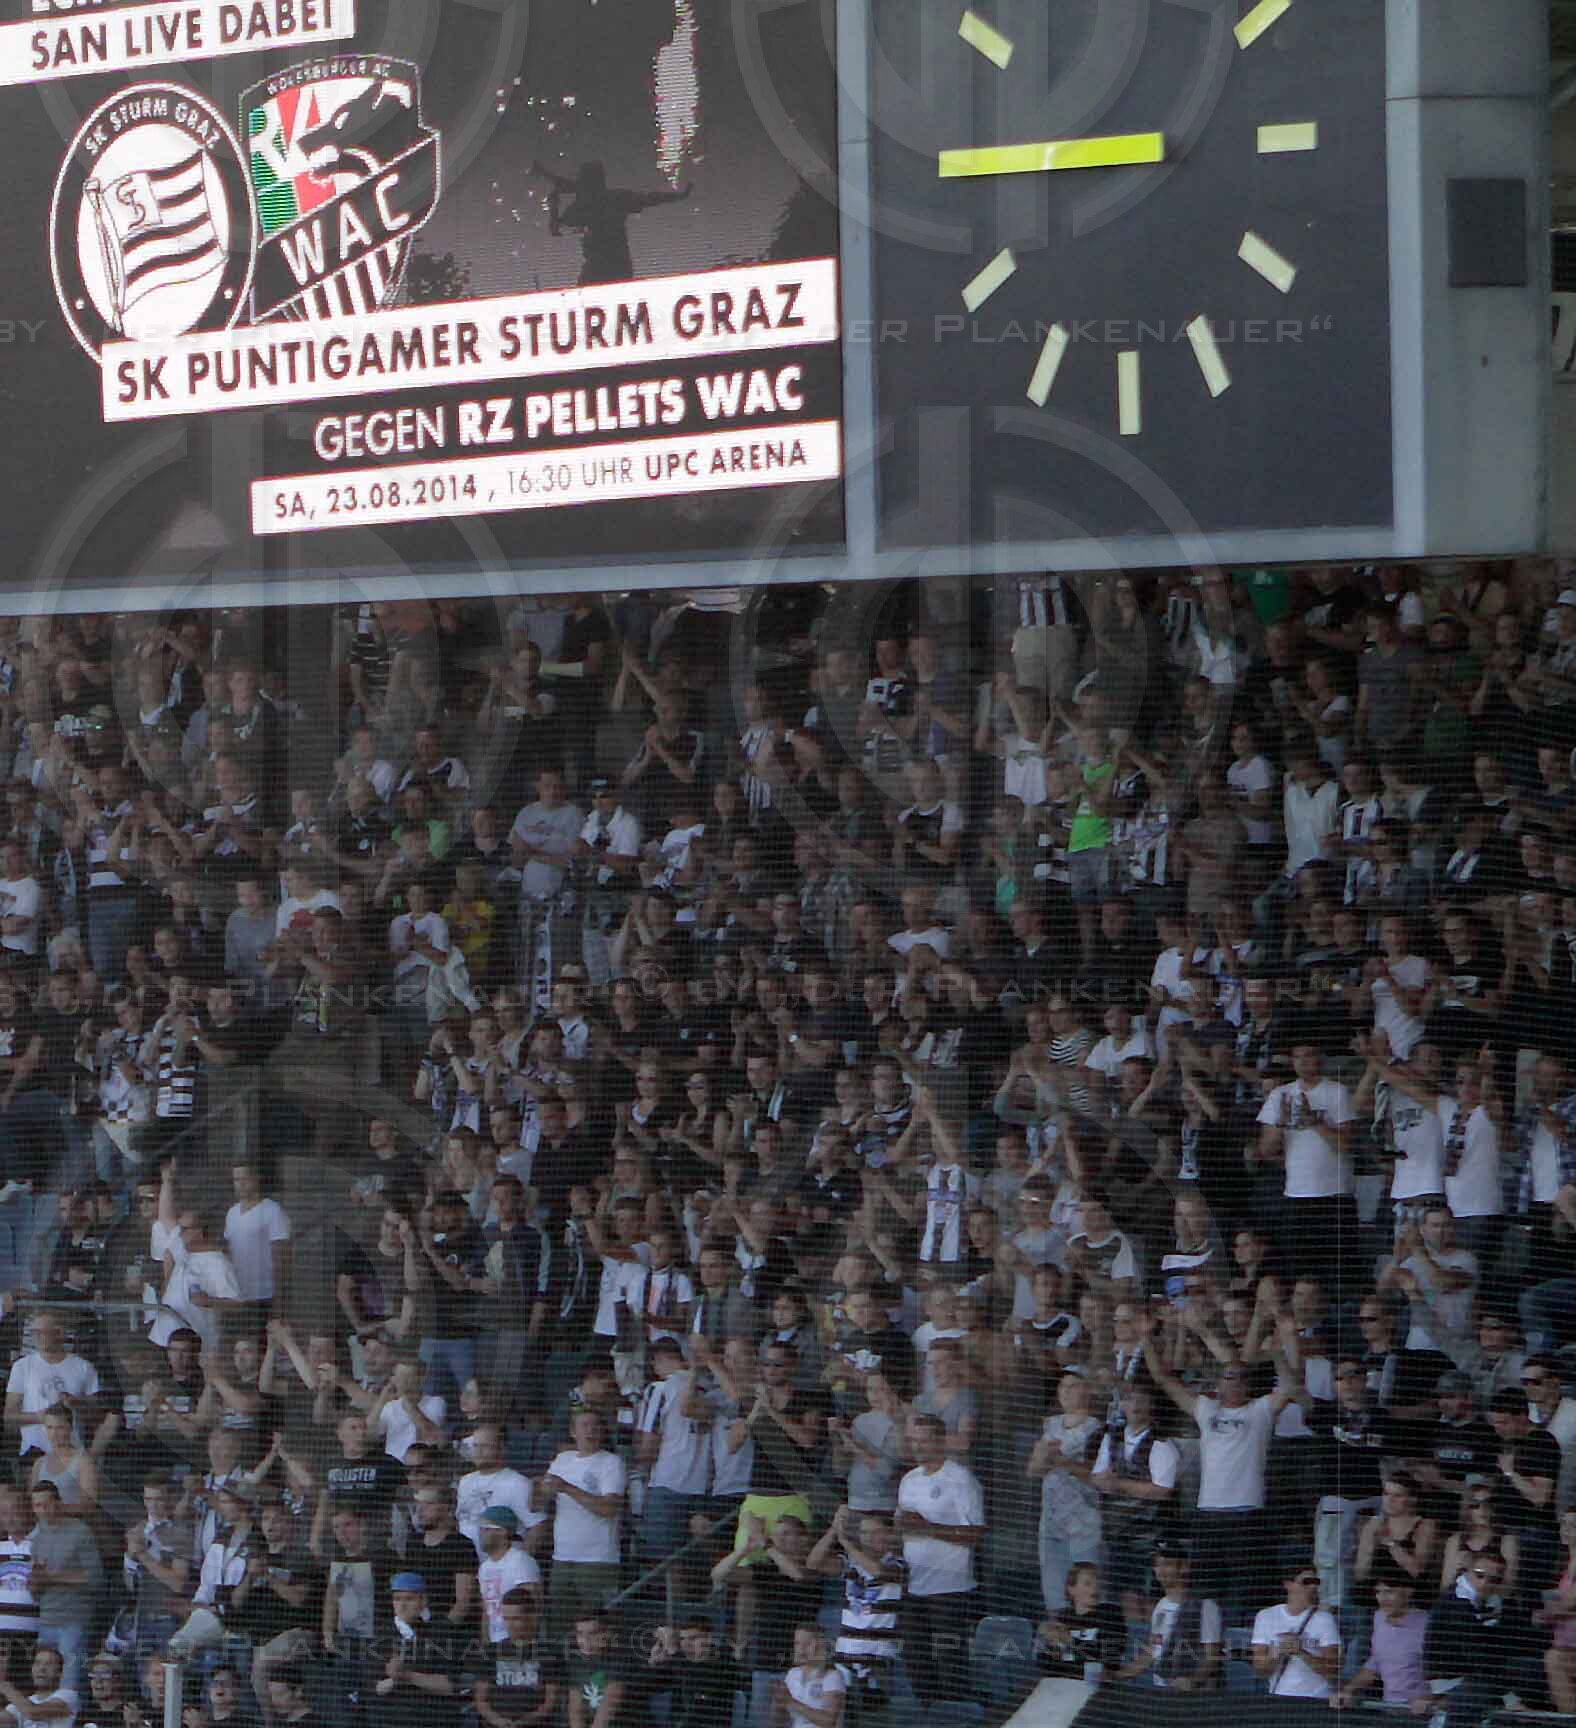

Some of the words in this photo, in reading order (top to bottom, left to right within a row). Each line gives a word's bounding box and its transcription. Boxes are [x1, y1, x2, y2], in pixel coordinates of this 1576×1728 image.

[31, 22, 108, 71] SAN
[124, 9, 203, 58] LIVE
[108, 97, 170, 133] STURM
[280, 173, 410, 286] WAC
[117, 355, 167, 402] SK
[187, 319, 482, 394] PUNTIGAMER
[500, 302, 654, 362] STURM
[671, 282, 808, 341] GRAZ
[315, 407, 447, 462] GEGEN
[458, 400, 514, 443] RZ
[525, 387, 686, 438] PELLETS
[697, 367, 804, 417] WAC
[504, 462, 574, 498] 16:30
[580, 456, 636, 490] UHR
[644, 450, 700, 483] UPC
[708, 440, 808, 478] ARENA
